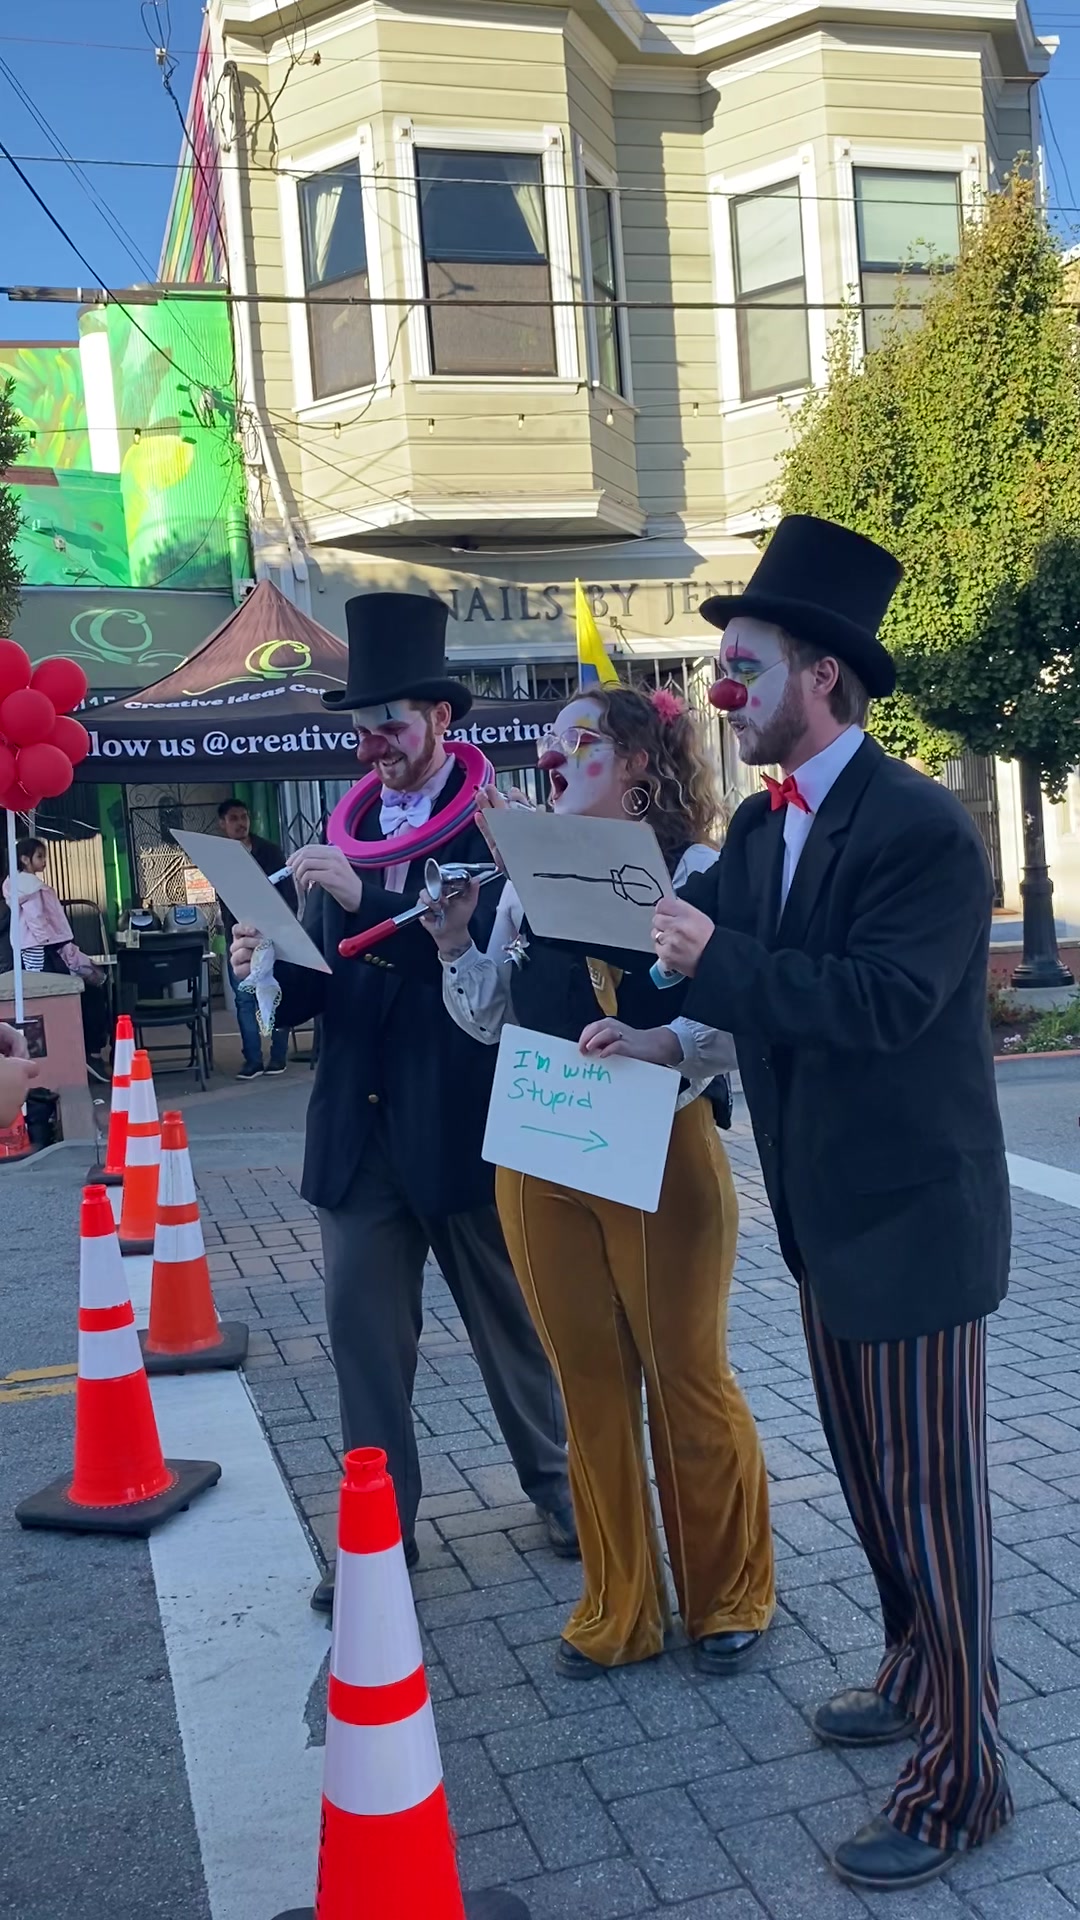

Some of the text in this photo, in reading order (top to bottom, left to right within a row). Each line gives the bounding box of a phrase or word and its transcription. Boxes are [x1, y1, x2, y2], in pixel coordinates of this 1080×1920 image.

[428, 585, 563, 622] NAILS
[587, 583, 640, 618] BY
[123, 699, 224, 709] Creative
[227, 685, 286, 705] Ideas
[86, 730, 152, 757] low
[158, 738, 196, 757] us
[202, 724, 359, 756] @creative
[513, 1050, 612, 1084] I'm with
[507, 1077, 593, 1115] Stupid
